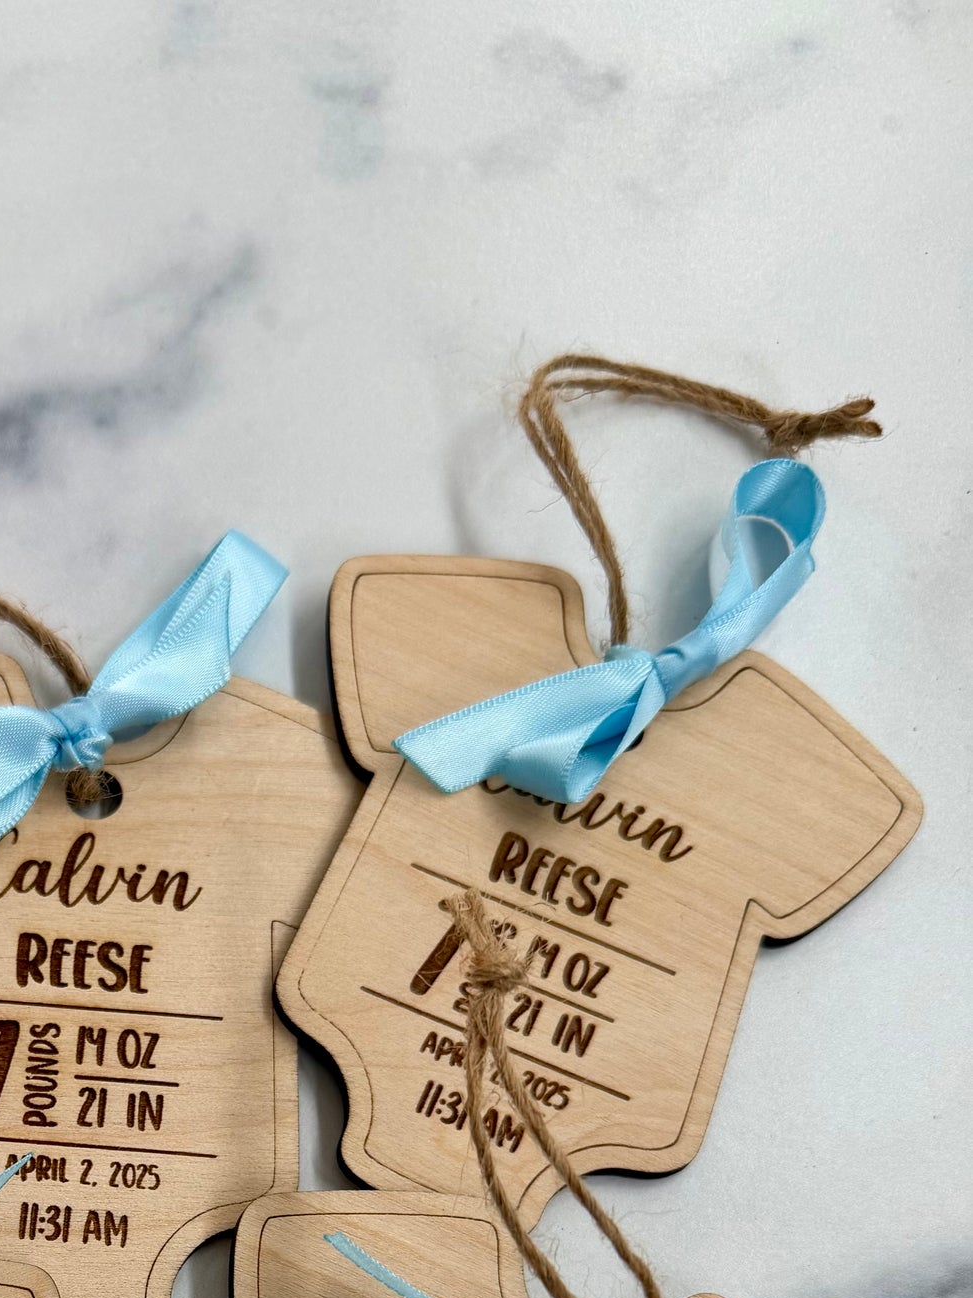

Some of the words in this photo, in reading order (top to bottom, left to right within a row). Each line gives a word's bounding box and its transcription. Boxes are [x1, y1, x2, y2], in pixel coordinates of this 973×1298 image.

[489, 831, 629, 927] REESE
[16, 932, 153, 994] REESE
[563, 953, 610, 998] OZ
[505, 993, 544, 1036] 21
[551, 1013, 596, 1058] IN
[117, 1028, 161, 1070] OZ
[22, 1022, 61, 1128] POUNDS
[77, 1087, 108, 1128] 21
[127, 1091, 164, 1132] IN
[109, 1161, 161, 1191] 2025
[18, 1202, 72, 1243] 11:31
[82, 1209, 128, 1248] AM
